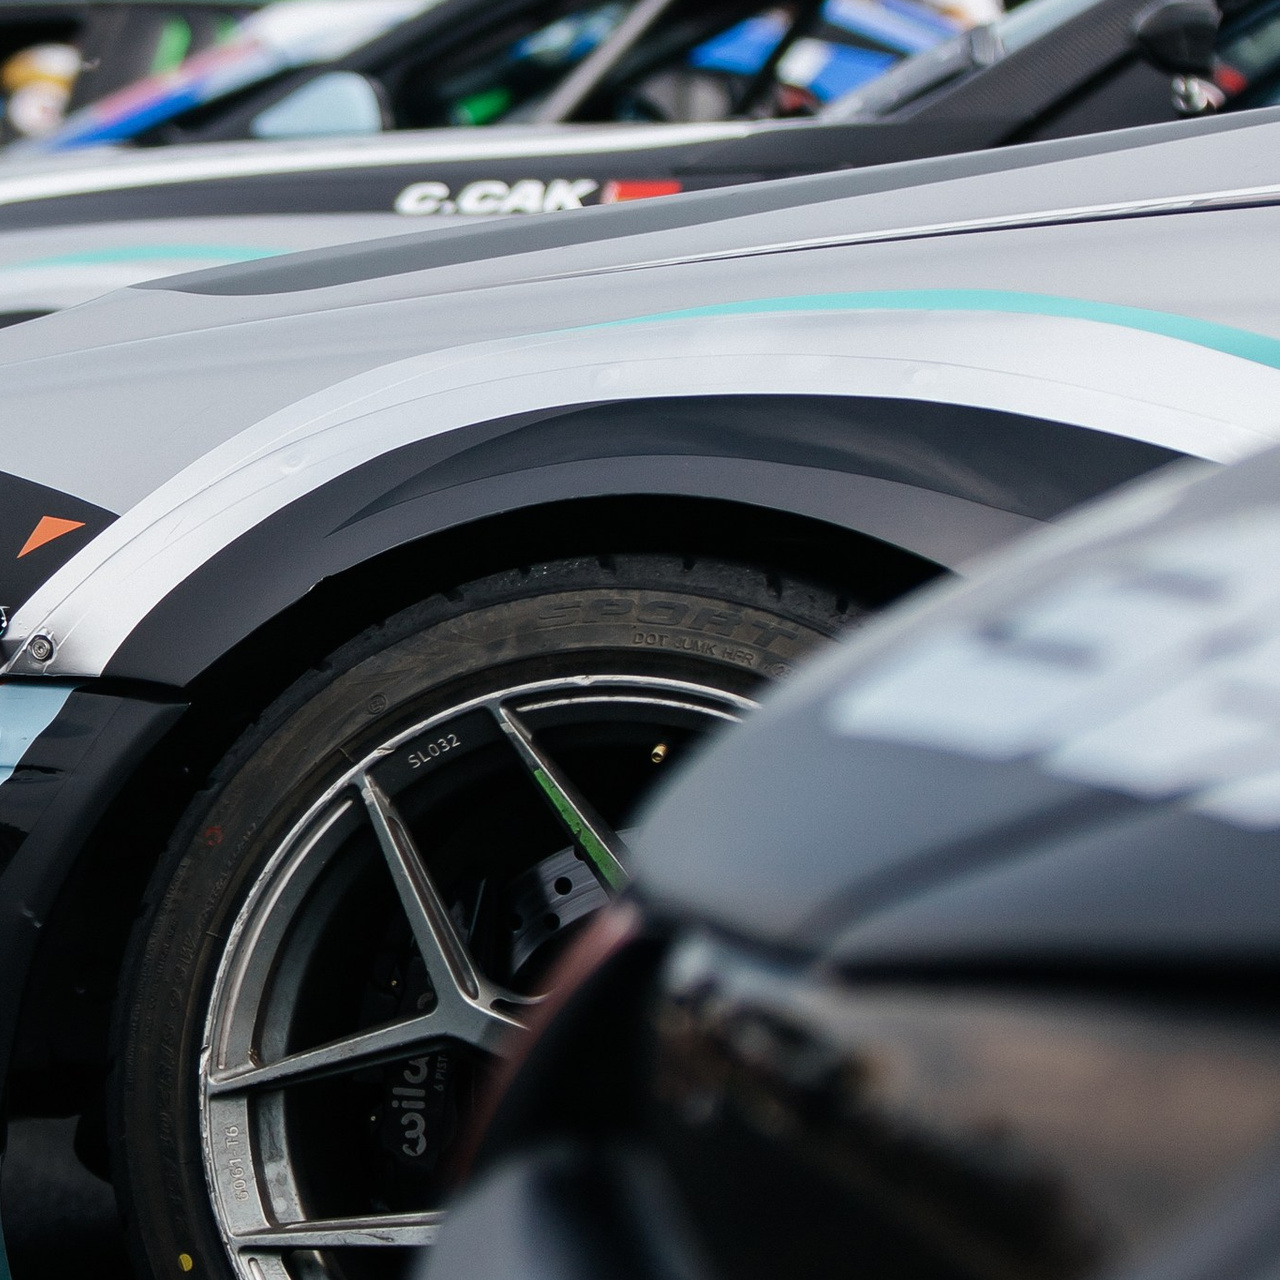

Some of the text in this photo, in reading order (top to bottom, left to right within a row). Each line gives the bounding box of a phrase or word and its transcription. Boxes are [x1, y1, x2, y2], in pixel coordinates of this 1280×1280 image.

[632, 631, 669, 647] DOT
[407, 733, 461, 769] SL032
[225, 1125, 250, 1201] 6061-T6
